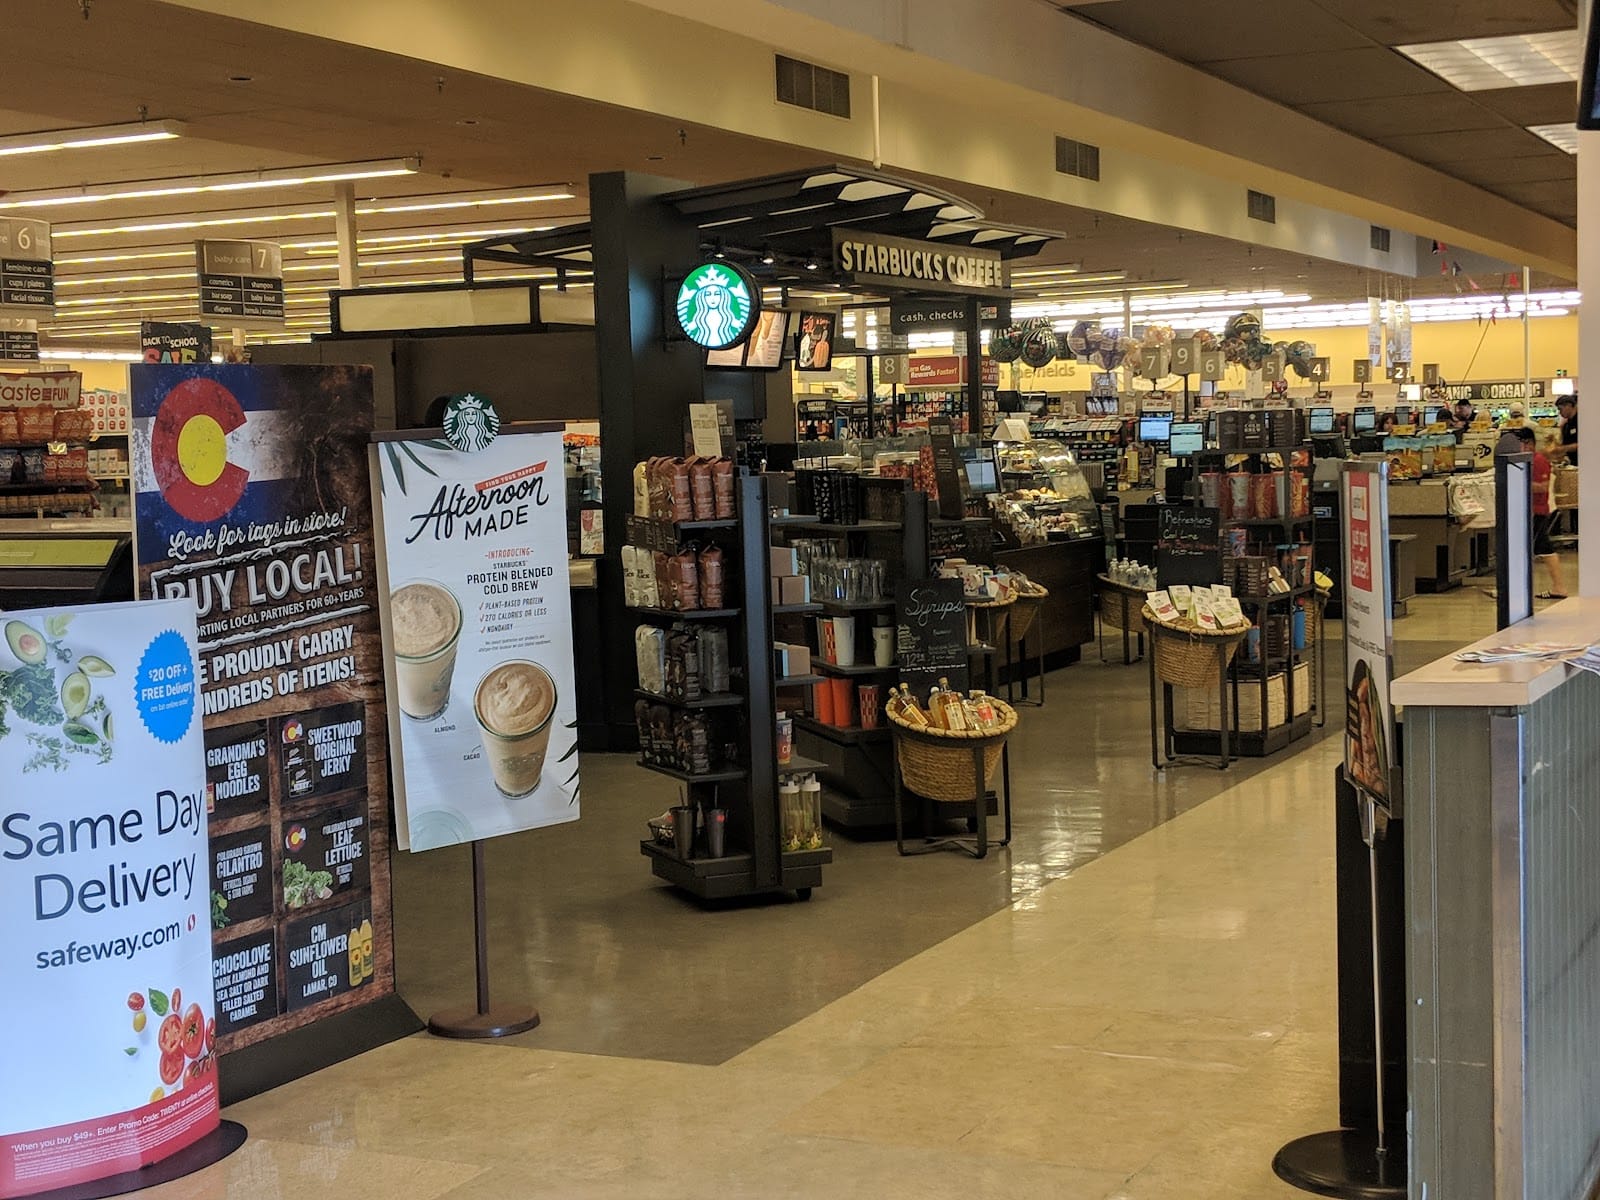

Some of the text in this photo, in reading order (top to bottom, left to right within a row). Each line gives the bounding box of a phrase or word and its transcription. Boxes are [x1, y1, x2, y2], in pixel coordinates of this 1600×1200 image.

[18, 227, 30, 249] 6
[214, 255, 233, 265] baby
[257, 249, 267, 269] 7
[842, 241, 1002, 287] STARBUCKS COFFEE
[251, 280, 275, 290] shampoo
[900, 309, 964, 323] cash, checks
[142, 336, 199, 348] BACK TO SCHOOL
[884, 358, 896, 376] 8
[1146, 355, 1156, 371] 7
[1176, 347, 1188, 369] 9
[1205, 358, 1215, 373] 6
[1265, 361, 1275, 376] 5
[910, 369, 936, 379] Rewards
[1312, 363, 1323, 377] 4
[1357, 365, 1366, 378] 3
[1394, 367, 1404, 379] 2
[52, 388, 70, 401] FUN
[405, 475, 549, 544] Afternoon
[465, 505, 529, 540] MADE
[168, 506, 348, 561] Look for tags in store!
[163, 543, 363, 618] BUY LOCAL!
[467, 566, 553, 584] PROTEIN BLENDED
[484, 580, 539, 595] COLD BREW
[230, 611, 260, 629] LOCAL
[260, 601, 305, 622] PARTNERS
[306, 596, 323, 611] FOR
[904, 588, 966, 627] Syrups
[212, 639, 294, 682] PROUDLY
[299, 624, 355, 660] CARRY
[148, 667, 165, 682] $20
[166, 663, 182, 680] OFF
[277, 669, 299, 696] OF
[302, 656, 356, 689] ITEMS!
[141, 681, 193, 702] FREE Delivery
[307, 719, 362, 746] SWEETWOOD
[434, 724, 456, 733] ALMOND
[206, 738, 266, 768] GRANDMA'S
[313, 737, 357, 762] ORIGINAL
[463, 752, 481, 761] CACAO
[227, 761, 247, 780] EGG
[320, 754, 352, 778] JERKY
[215, 774, 261, 801] NOODLES
[1, 789, 203, 861] Same Day
[332, 828, 354, 849] LEAF
[325, 841, 363, 867] LETTUCE
[216, 851, 264, 879] CILANTRO
[34, 853, 196, 921] Delivery
[311, 923, 327, 943] CM
[36, 922, 180, 969] safeway.com
[289, 934, 348, 969] SUNFLOWER
[212, 943, 272, 979] CHOCOLOVE
[311, 958, 328, 979] OIL
[303, 974, 338, 998] LAMAR, CO
[229, 1004, 258, 1022] CARAMEL
[39, 1138, 56, 1149] you
[97, 1124, 118, 1137] Enter
[118, 1118, 142, 1131] Promo
